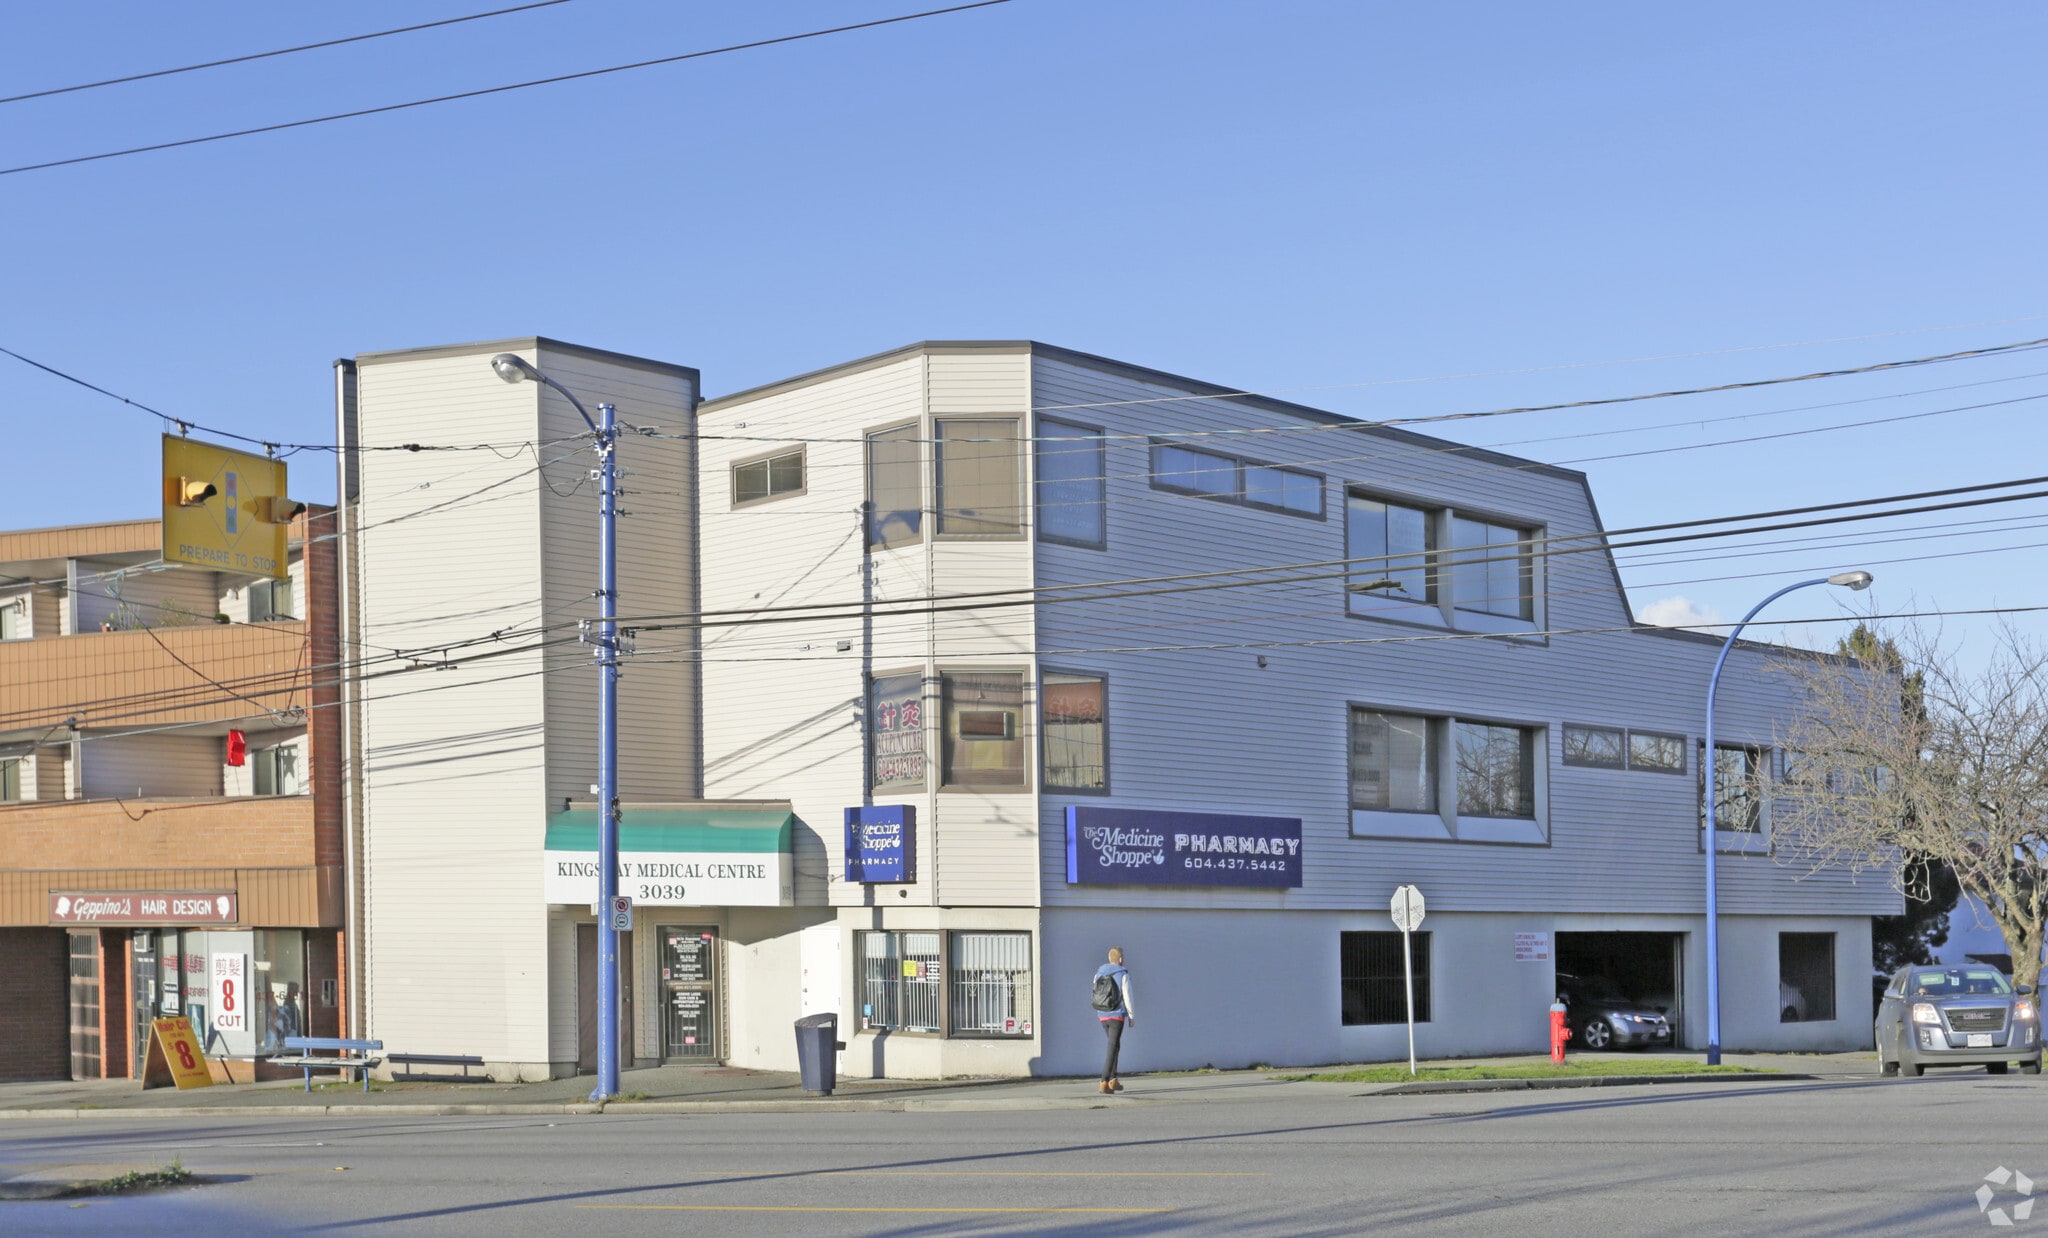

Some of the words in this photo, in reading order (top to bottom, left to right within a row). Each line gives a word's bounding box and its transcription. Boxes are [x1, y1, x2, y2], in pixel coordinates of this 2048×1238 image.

[179, 544, 231, 564] PREPARE
[235, 553, 249, 567] TO
[253, 557, 277, 571] STOP
[877, 731, 922, 755] ACUPUNCTURE
[1083, 826, 1098, 839] The
[1092, 826, 1164, 850] Medicine
[1174, 833, 1300, 856] PHARMACY
[848, 857, 899, 866] PHARMACY
[1100, 844, 1152, 867] Shoppe
[1184, 857, 1286, 871] 604.437.5442
[558, 862, 632, 878] KINGSAY
[637, 863, 704, 878] MEDICAL
[707, 863, 766, 879] CENTRE
[639, 884, 686, 900] 3039
[141, 899, 168, 915] HAIR
[173, 899, 212, 915] DESIGN
[217, 1014, 242, 1027] CUT
